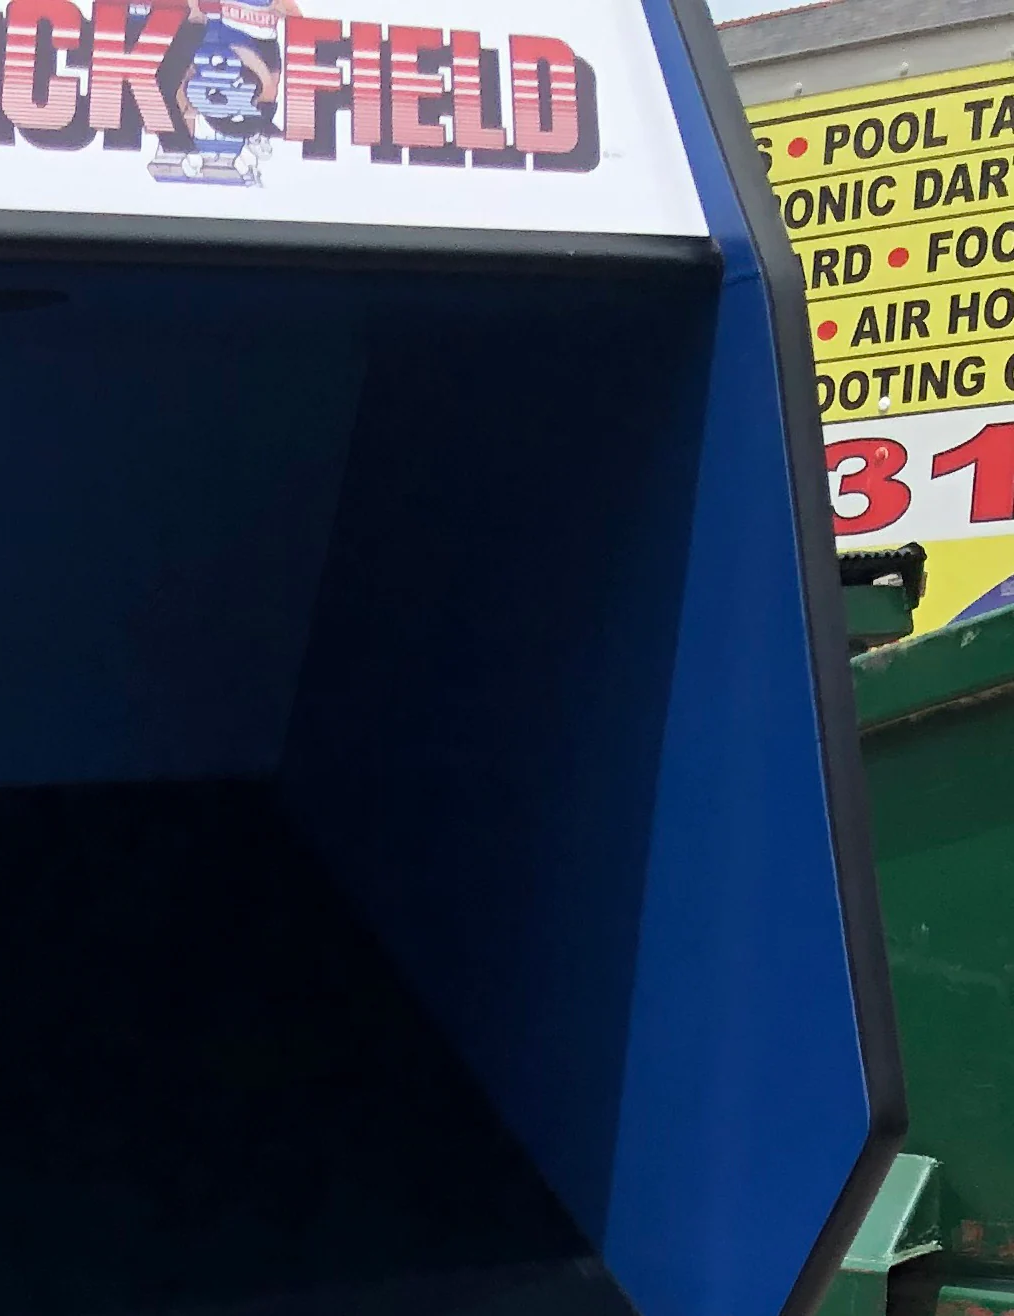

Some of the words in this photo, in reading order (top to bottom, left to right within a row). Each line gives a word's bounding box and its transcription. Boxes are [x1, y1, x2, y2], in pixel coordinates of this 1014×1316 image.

[285, 15, 600, 173] FIELD
[823, 107, 948, 165] POOL
[774, 175, 896, 230] ONIC
[913, 157, 1014, 210] DAR
[850, 299, 931, 347] AIR
